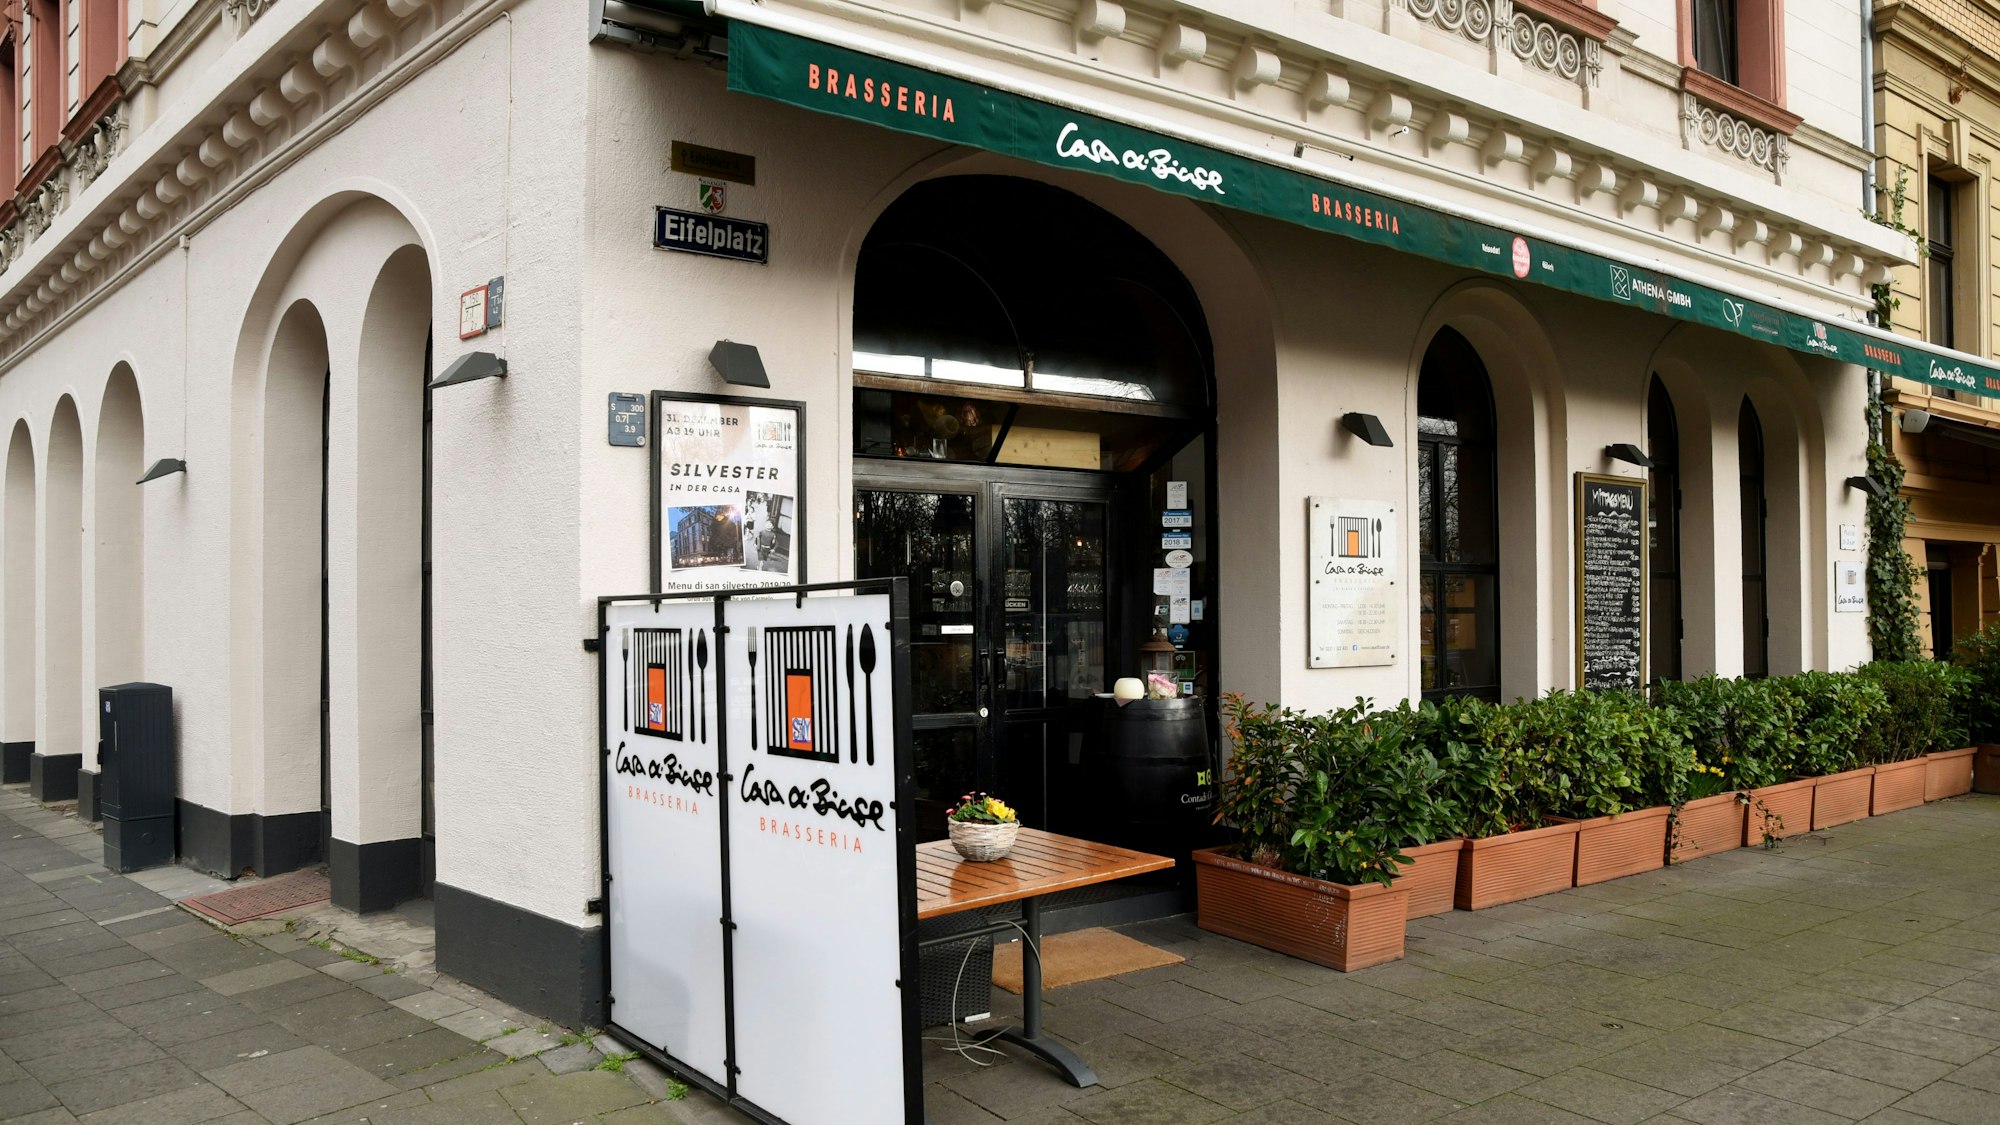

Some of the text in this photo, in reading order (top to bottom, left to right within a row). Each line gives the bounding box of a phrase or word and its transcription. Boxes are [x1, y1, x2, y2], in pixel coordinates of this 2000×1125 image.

[808, 63, 955, 124] BRASSERIA
[1056, 122, 1120, 165] Casa
[1311, 192, 1400, 235] BRASSERIA
[664, 213, 763, 255] Eifelplatz
[1632, 278, 1692, 308] ATHENA GMBH
[1864, 344, 1901, 366] BRASSERIA
[611, 403, 645, 413] S 300
[698, 428, 721, 438] UHR
[670, 463, 780, 481] SILVESTER
[712, 485, 741, 493] CASA
[1325, 561, 1347, 575] Casa
[668, 582, 692, 590] Menu
[695, 581, 703, 590] di
[722, 581, 758, 590] silvestro
[616, 741, 646, 776] Casa
[741, 763, 785, 806] Casa
[628, 785, 699, 816] BRASSERIA
[760, 817, 862, 853] BRASSERIA
